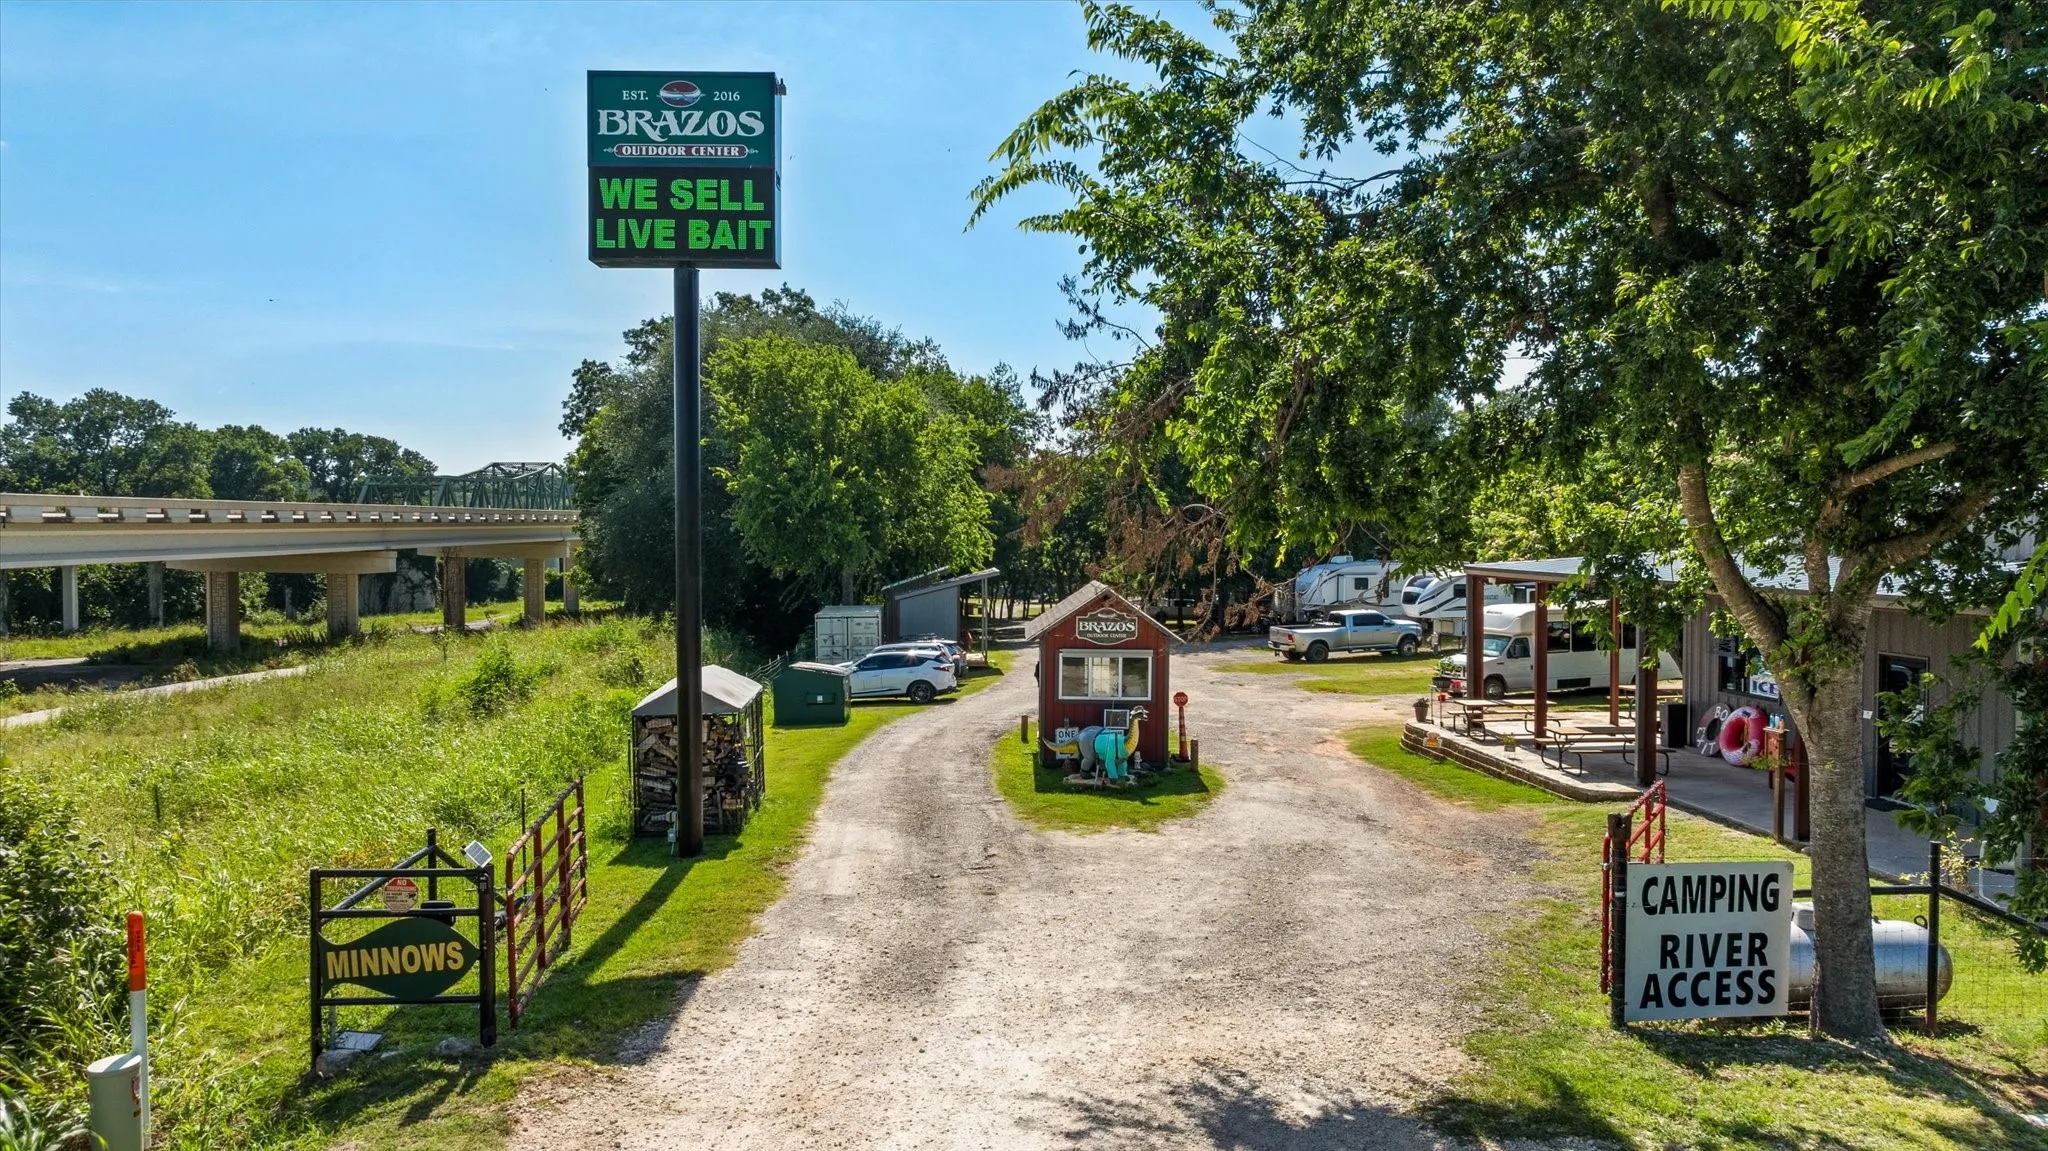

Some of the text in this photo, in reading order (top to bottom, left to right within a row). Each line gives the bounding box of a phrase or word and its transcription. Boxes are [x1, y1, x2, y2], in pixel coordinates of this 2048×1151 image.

[622, 90, 740, 101] EST. 2016
[597, 109, 765, 142] BRAZOS
[622, 145, 740, 157] OUTDOOR CENTER
[599, 178, 765, 211] WE SELL
[596, 218, 772, 250] LIVE BAIT
[1079, 621, 1136, 633] BRAZOS
[1752, 680, 1778, 694] ICE
[1058, 730, 1075, 739] ONE
[1641, 873, 1780, 916] CAMPING
[326, 941, 465, 980] MINNOWS
[1659, 932, 1769, 969] RIVER
[1639, 969, 1776, 1010] ACCESS
